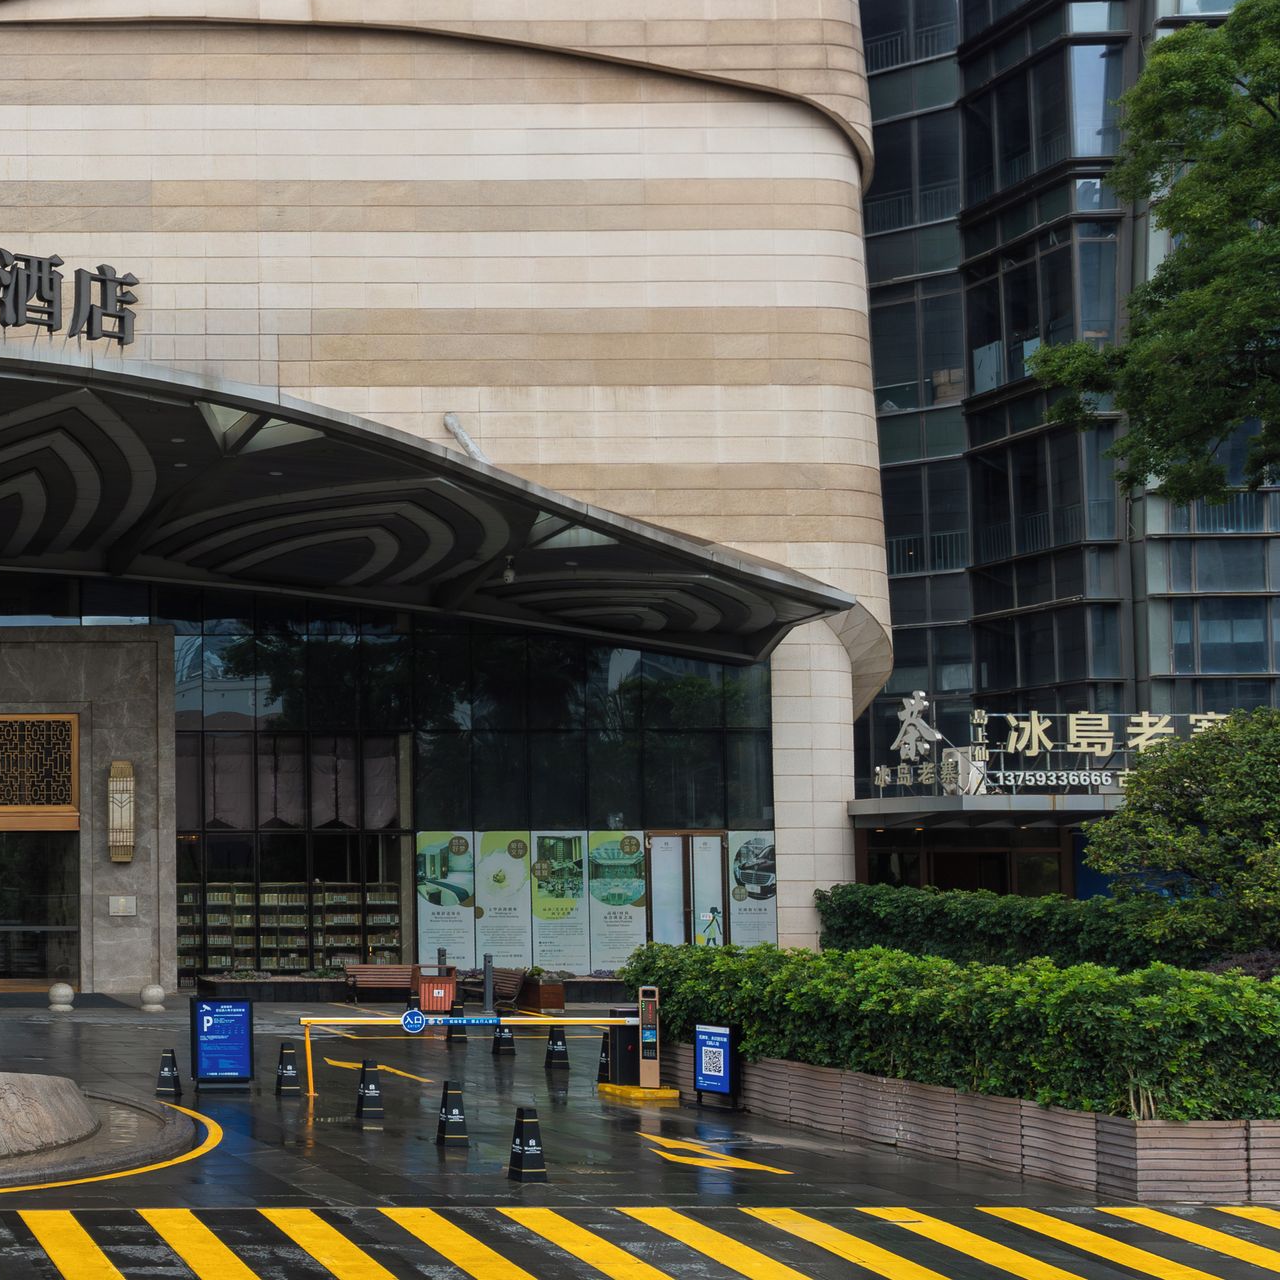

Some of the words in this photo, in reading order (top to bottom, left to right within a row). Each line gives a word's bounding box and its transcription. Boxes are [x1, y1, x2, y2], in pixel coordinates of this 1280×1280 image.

[890, 690, 942, 761] 茶
[997, 771, 1112, 786] 13759336666
[204, 1016, 213, 1032] P
[405, 1016, 422, 1024] 入口
